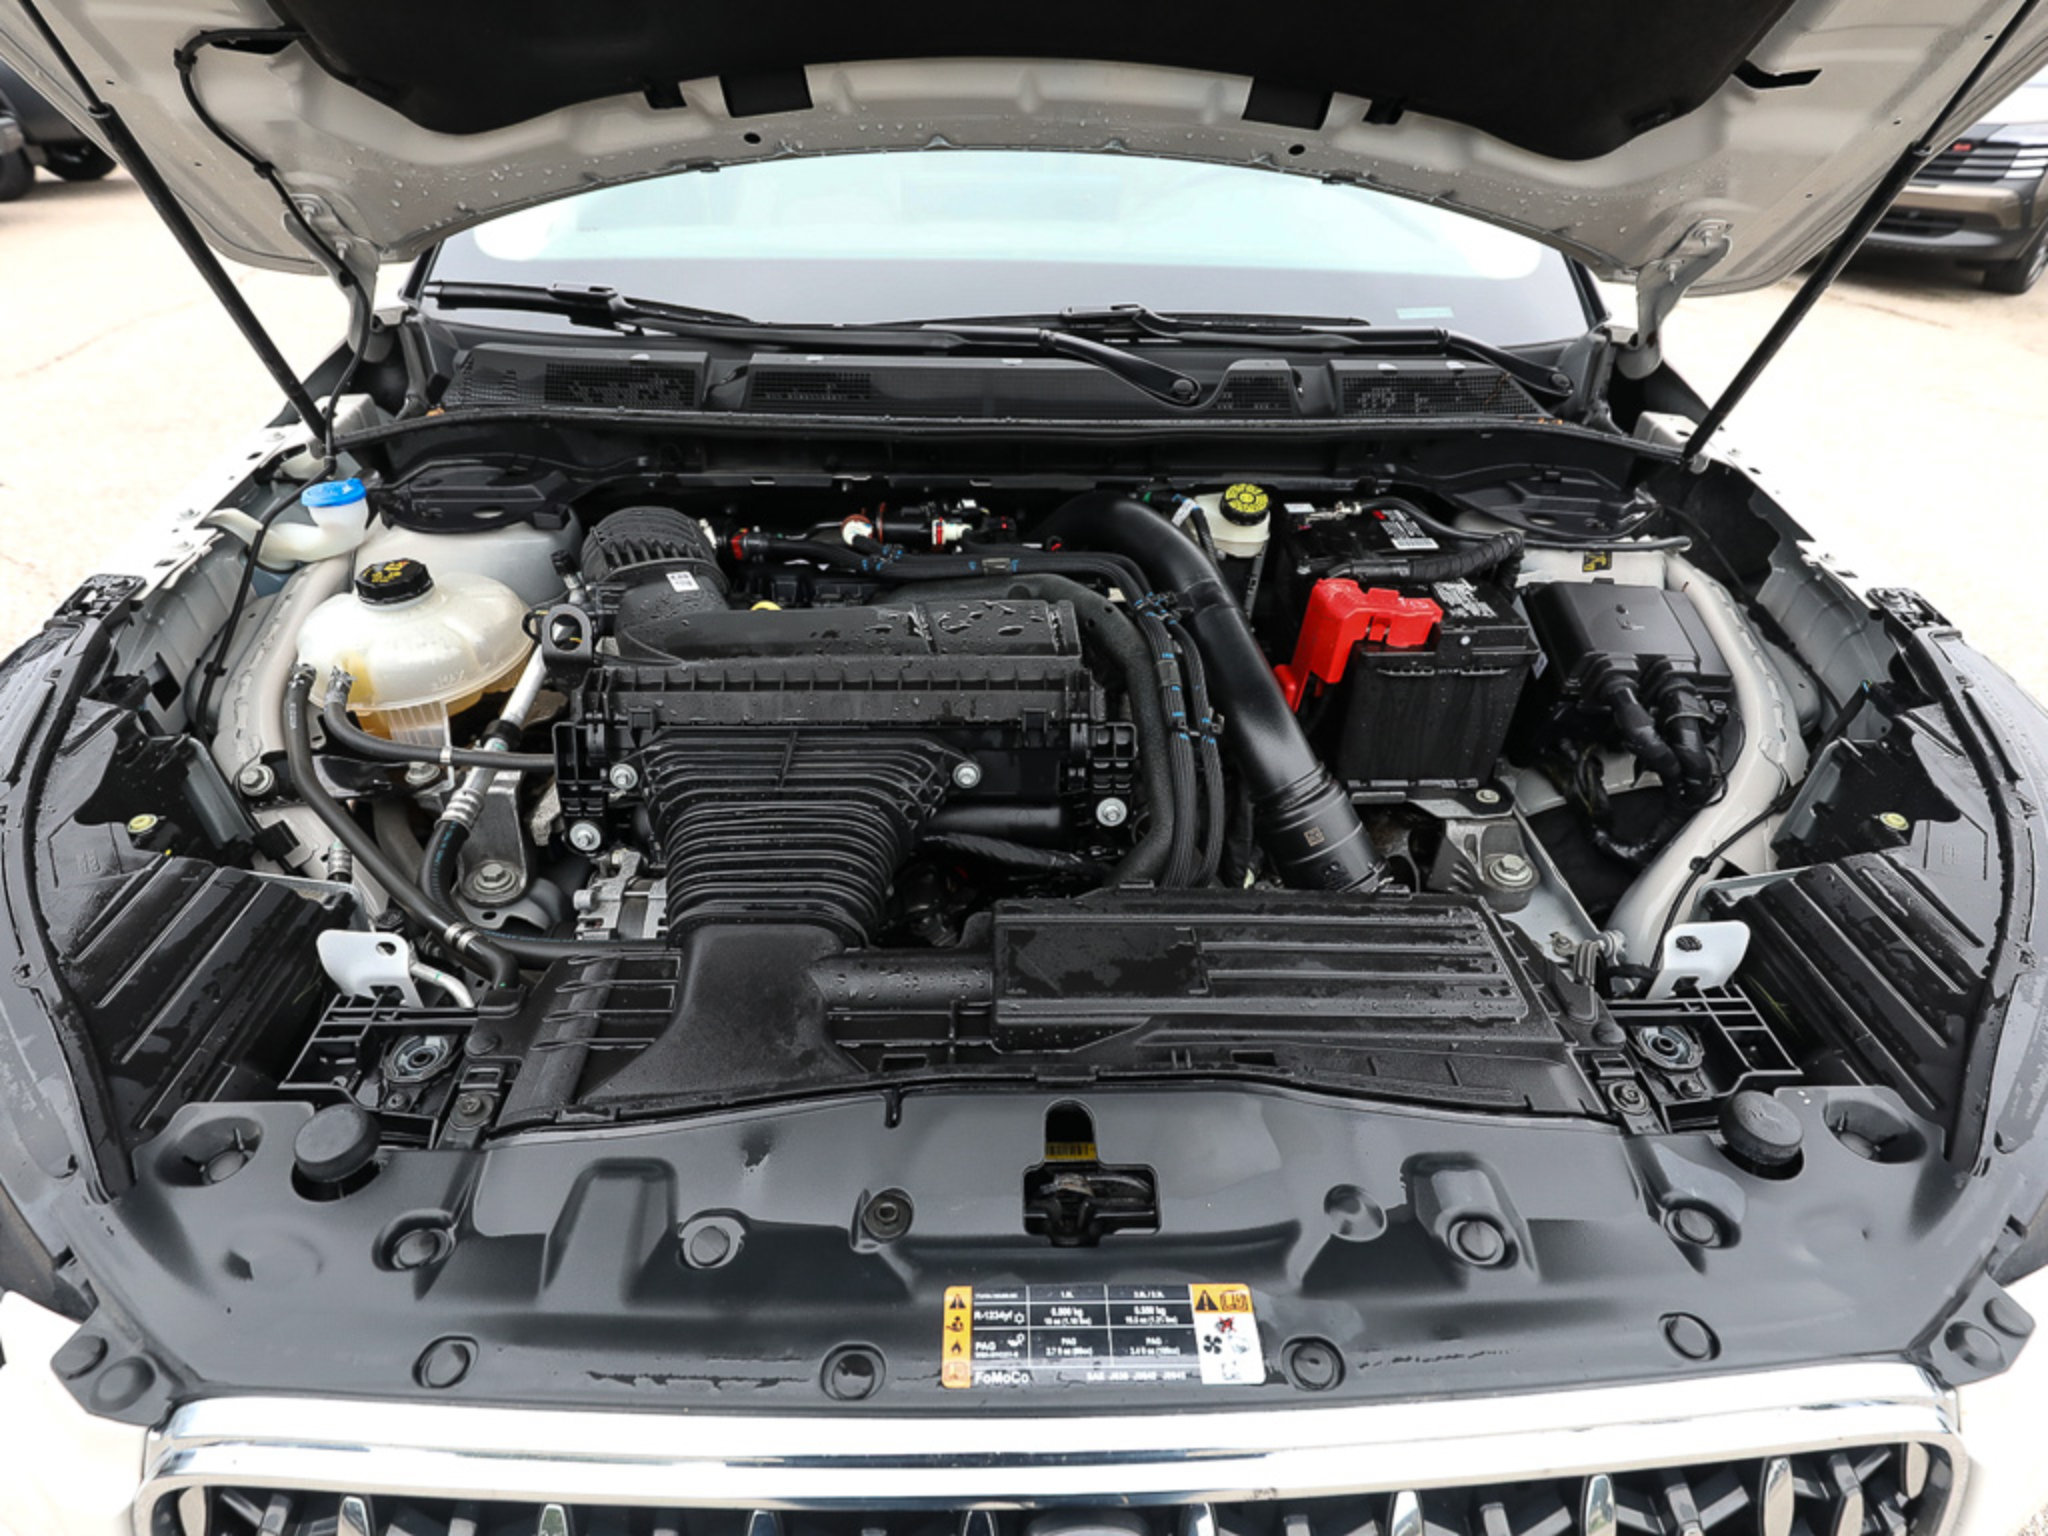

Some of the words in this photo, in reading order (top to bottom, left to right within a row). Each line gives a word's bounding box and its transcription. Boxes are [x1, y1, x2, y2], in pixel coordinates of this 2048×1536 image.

[974, 1310, 1013, 1322] R-1234yf
[975, 1341, 997, 1351] PAG
[1061, 1337, 1078, 1346] PAG
[974, 1370, 1030, 1384] FoMoCo
